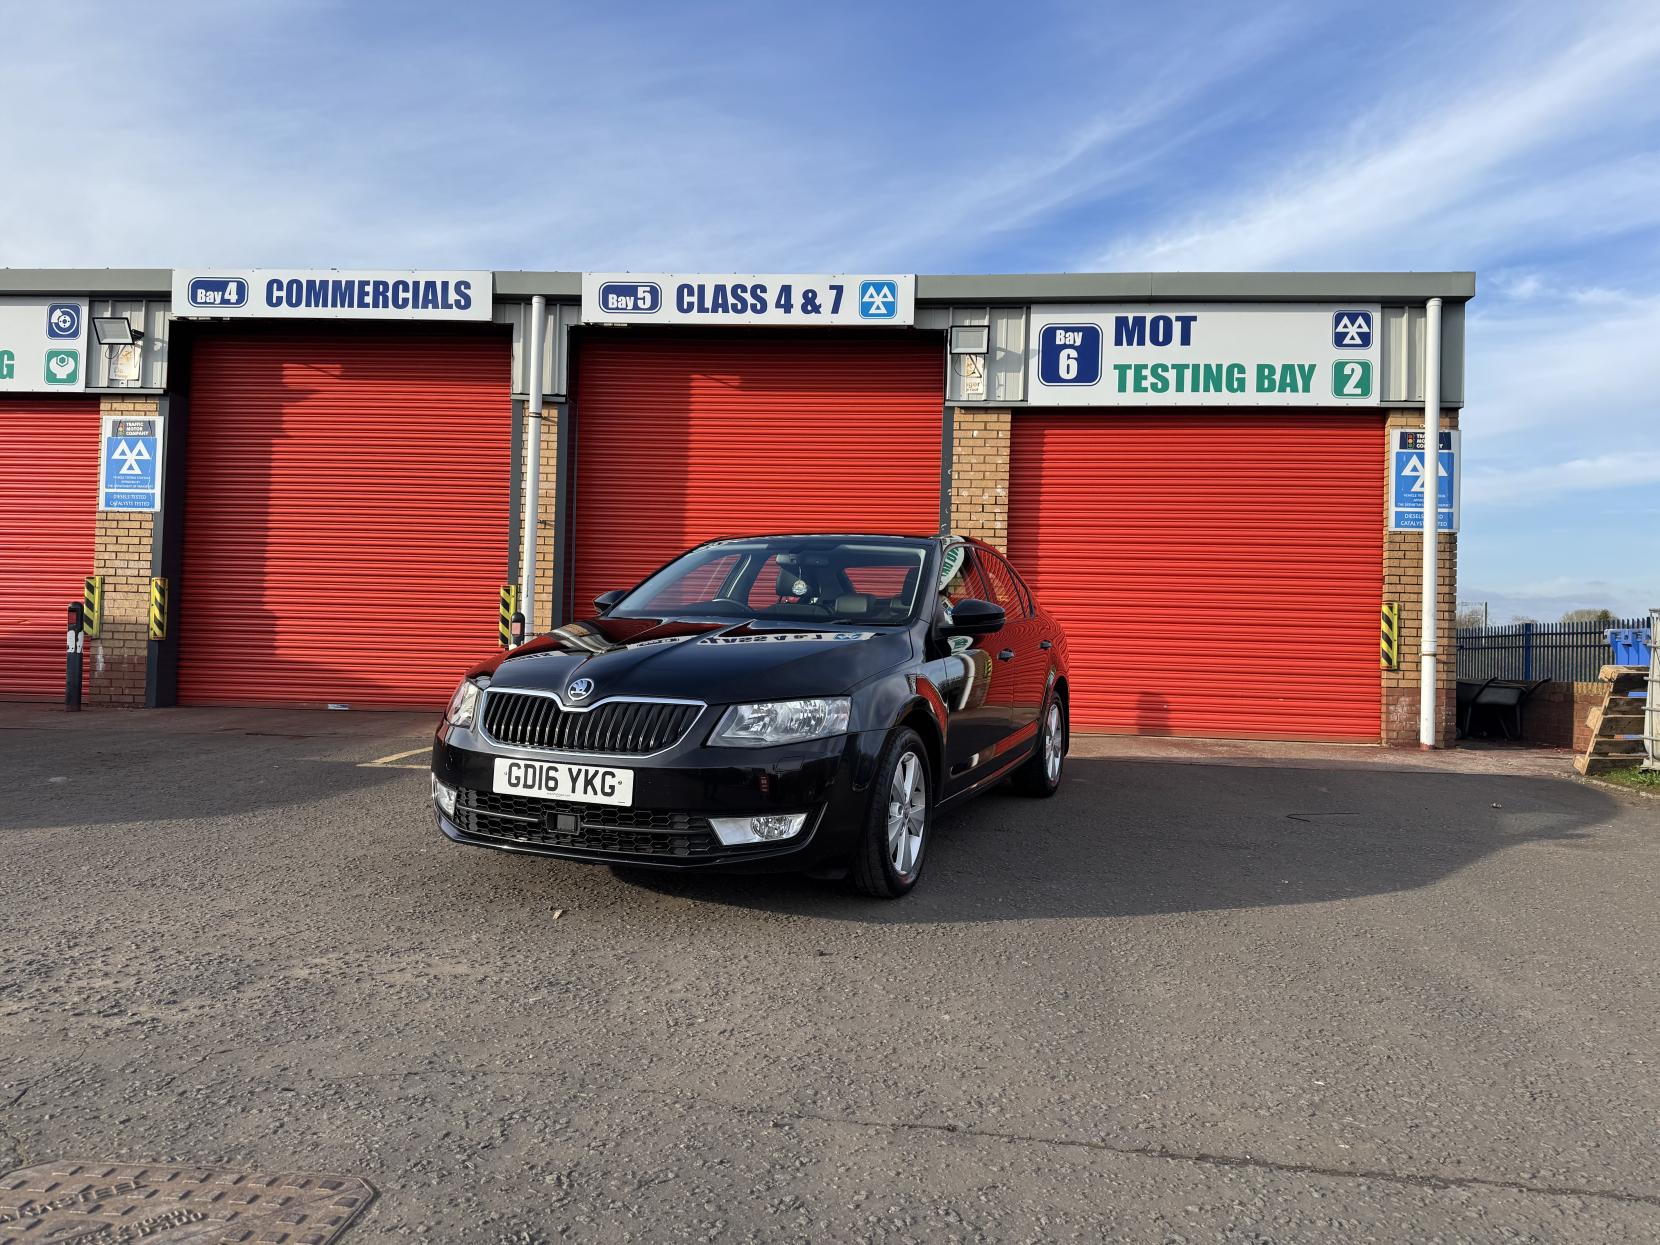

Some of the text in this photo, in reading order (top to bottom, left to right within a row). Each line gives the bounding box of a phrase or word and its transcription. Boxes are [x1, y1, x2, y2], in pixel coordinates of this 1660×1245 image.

[197, 282, 238, 304] Bay 4
[265, 278, 472, 310] COMMERCIALS
[608, 286, 652, 310] Bay 5
[675, 283, 844, 315] CLASS 4 & 7
[1055, 329, 1083, 347] Bay
[1113, 314, 1198, 347] MOT
[1058, 348, 1079, 380] 6
[1113, 363, 1317, 394] TESTING BAY
[1343, 362, 1363, 395] 2
[507, 761, 617, 797] GD16 YKG
